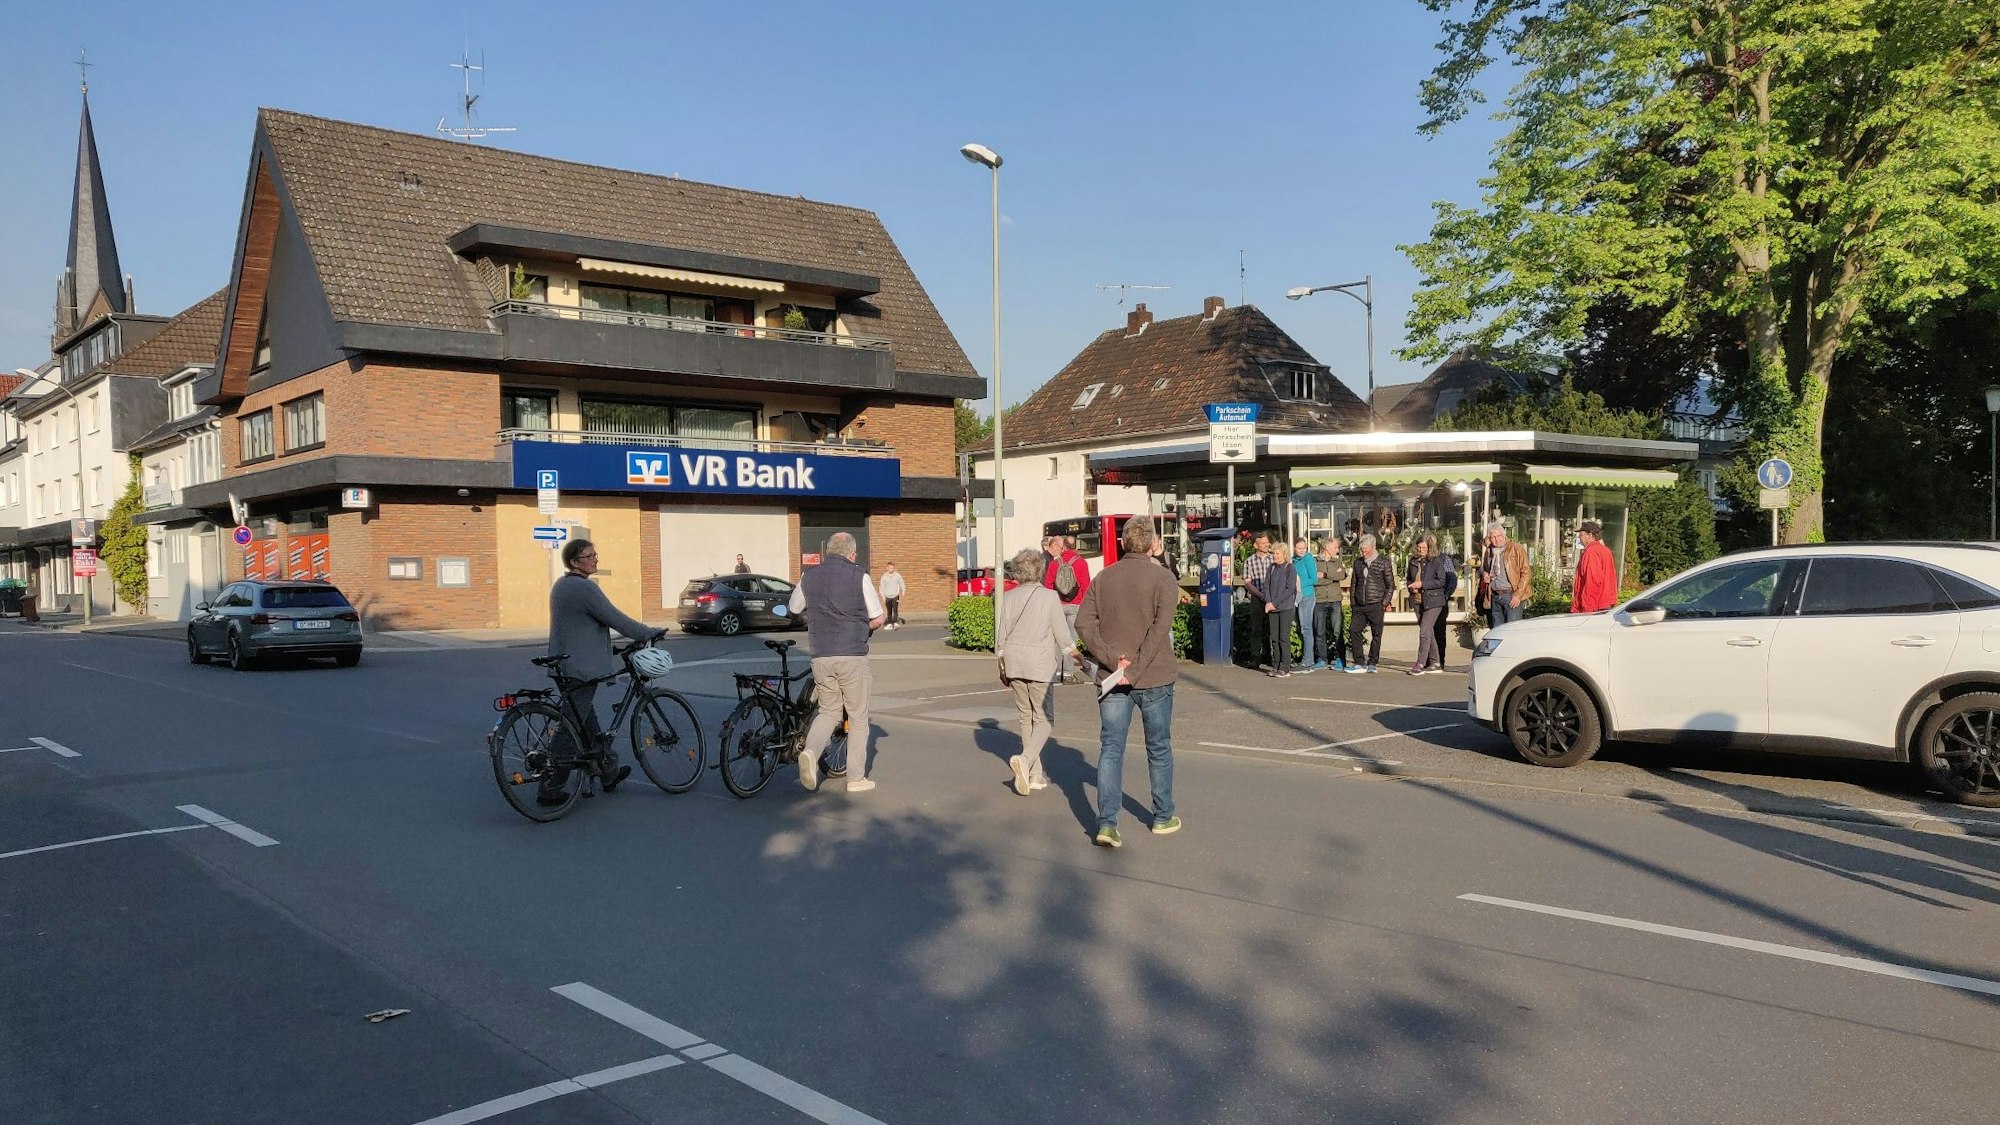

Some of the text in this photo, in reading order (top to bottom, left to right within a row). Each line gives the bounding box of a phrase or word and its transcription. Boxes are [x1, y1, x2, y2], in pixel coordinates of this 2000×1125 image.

[1215, 405, 1251, 414] Parkschein
[1219, 413, 1247, 421] Automat
[679, 454, 816, 490] VR Bank
[541, 472, 553, 487] P
[1224, 540, 1231, 553] P
